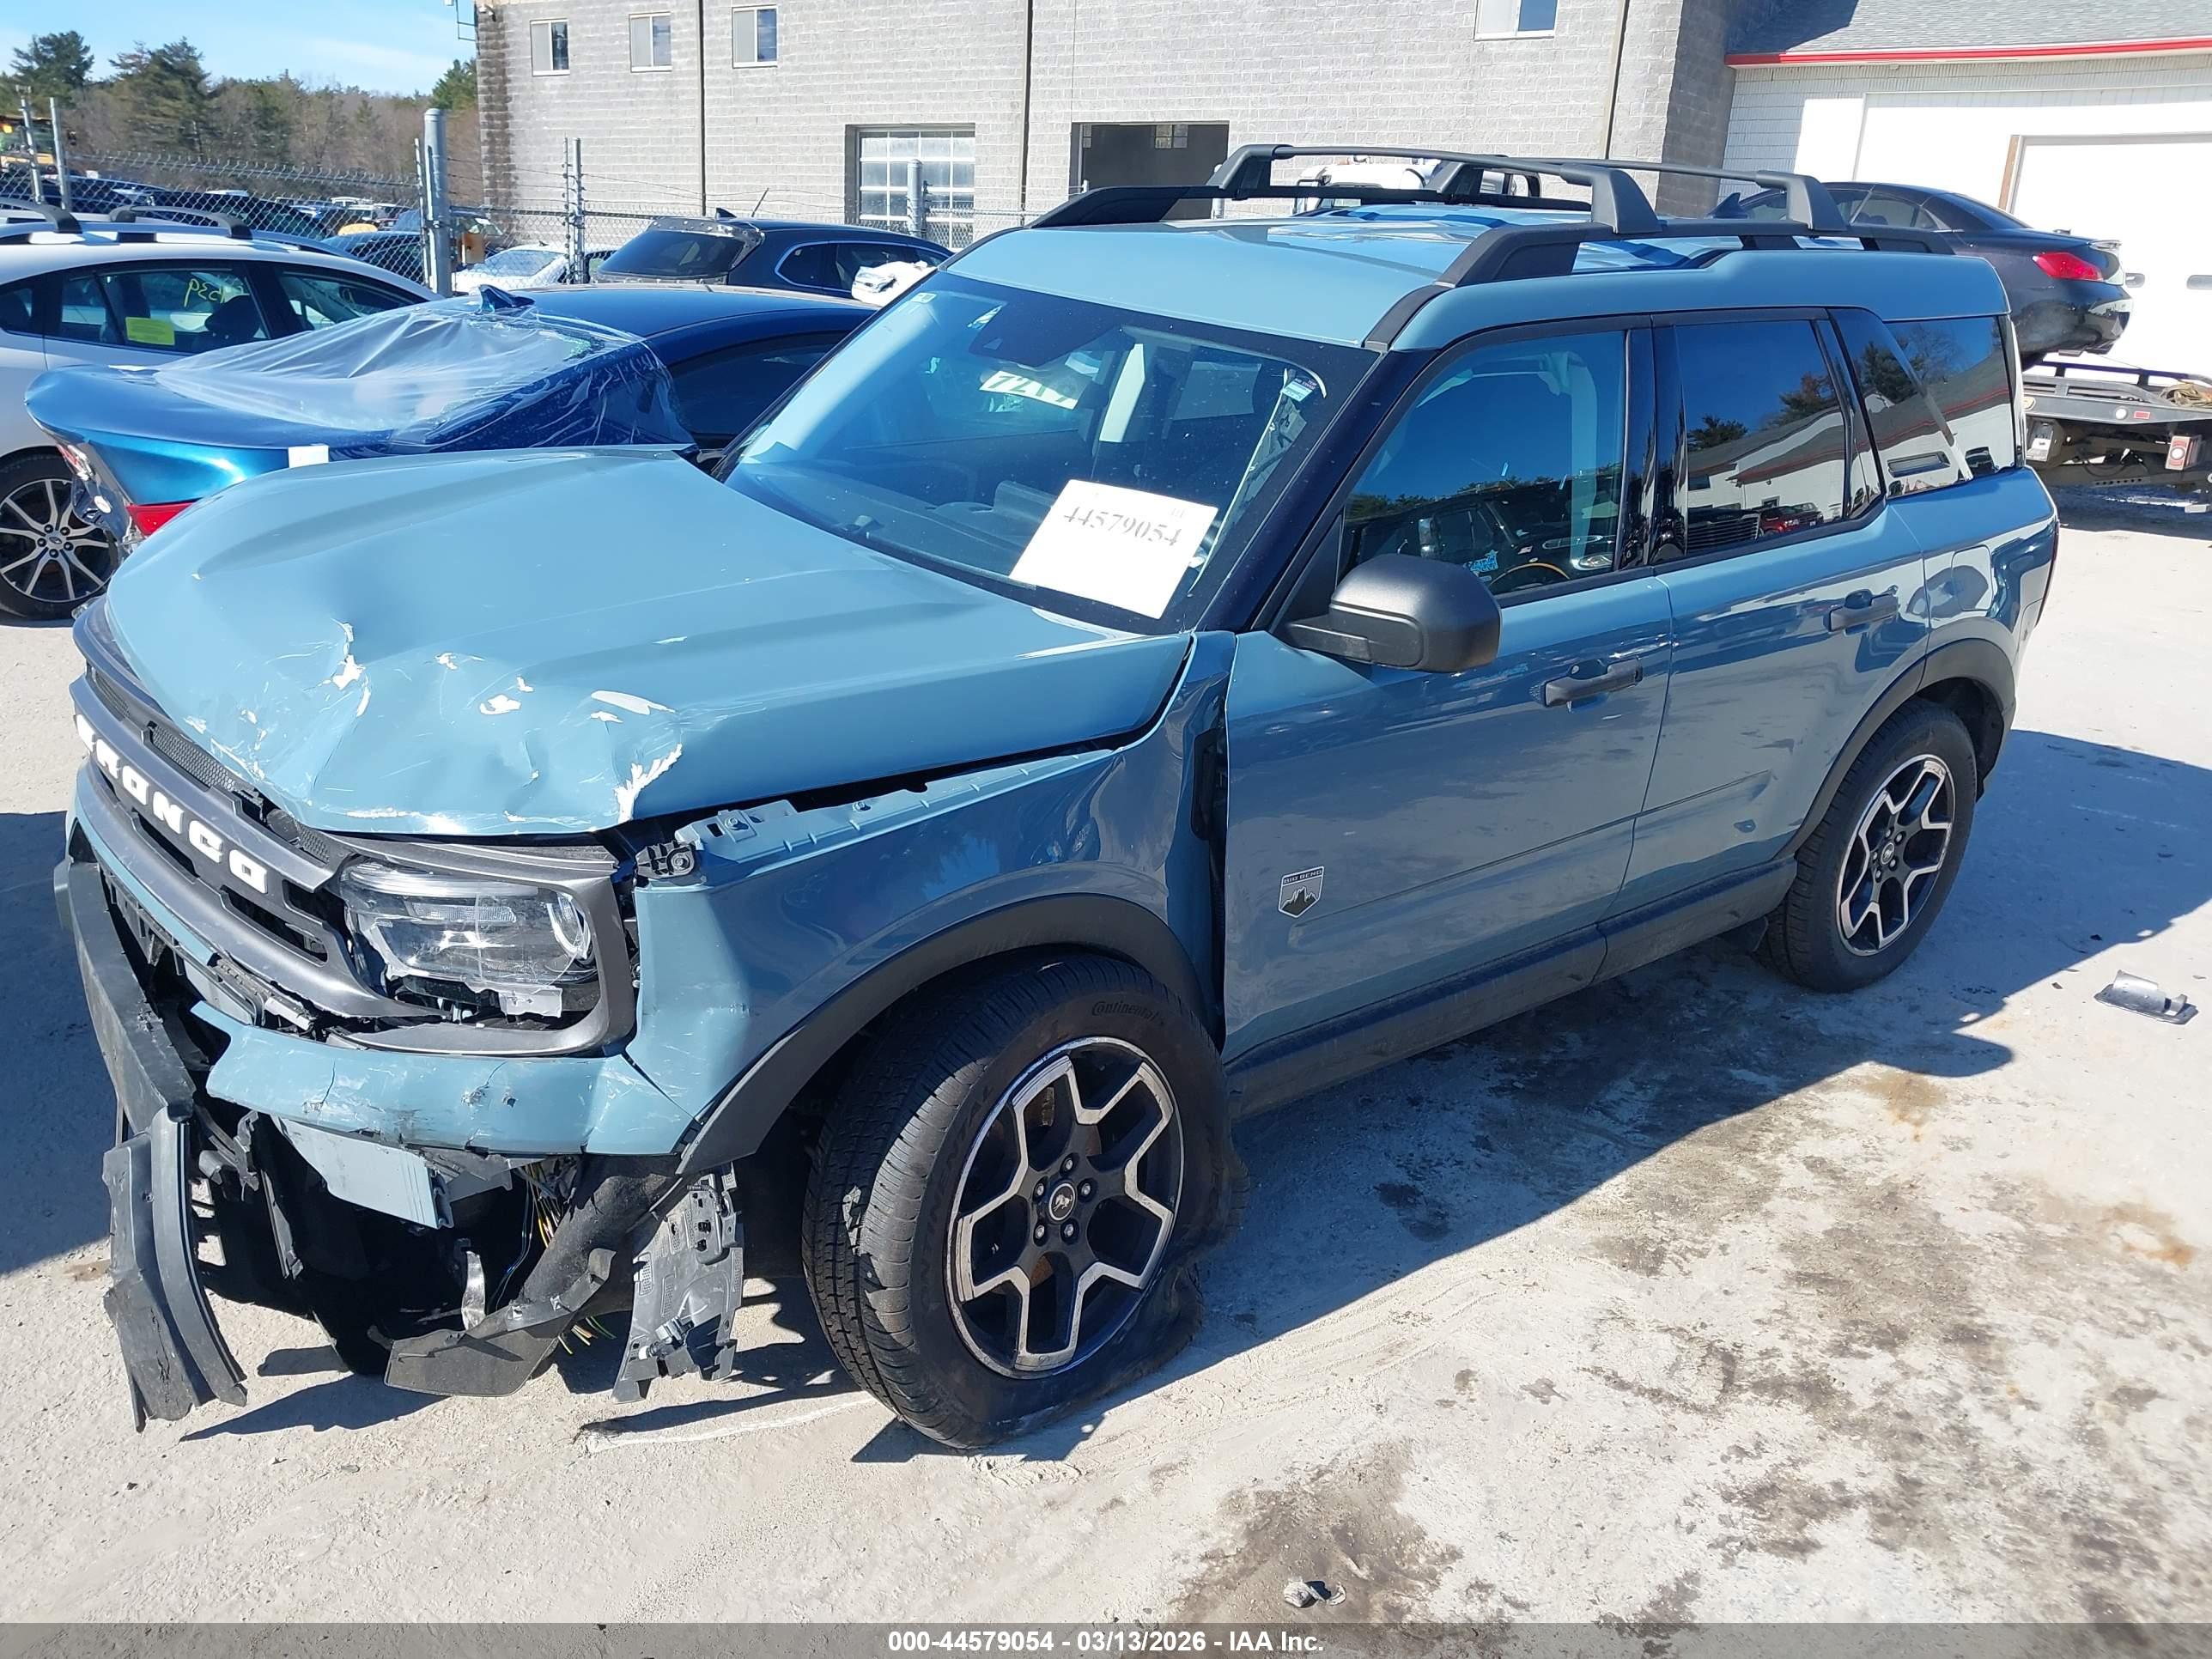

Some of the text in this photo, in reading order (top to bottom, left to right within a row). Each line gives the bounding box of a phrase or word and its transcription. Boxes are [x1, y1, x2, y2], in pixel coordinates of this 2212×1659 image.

[1063, 506, 1182, 546] 44579054
[1299, 869, 1322, 879] BEND
[1091, 1000, 1159, 1022] Continental
